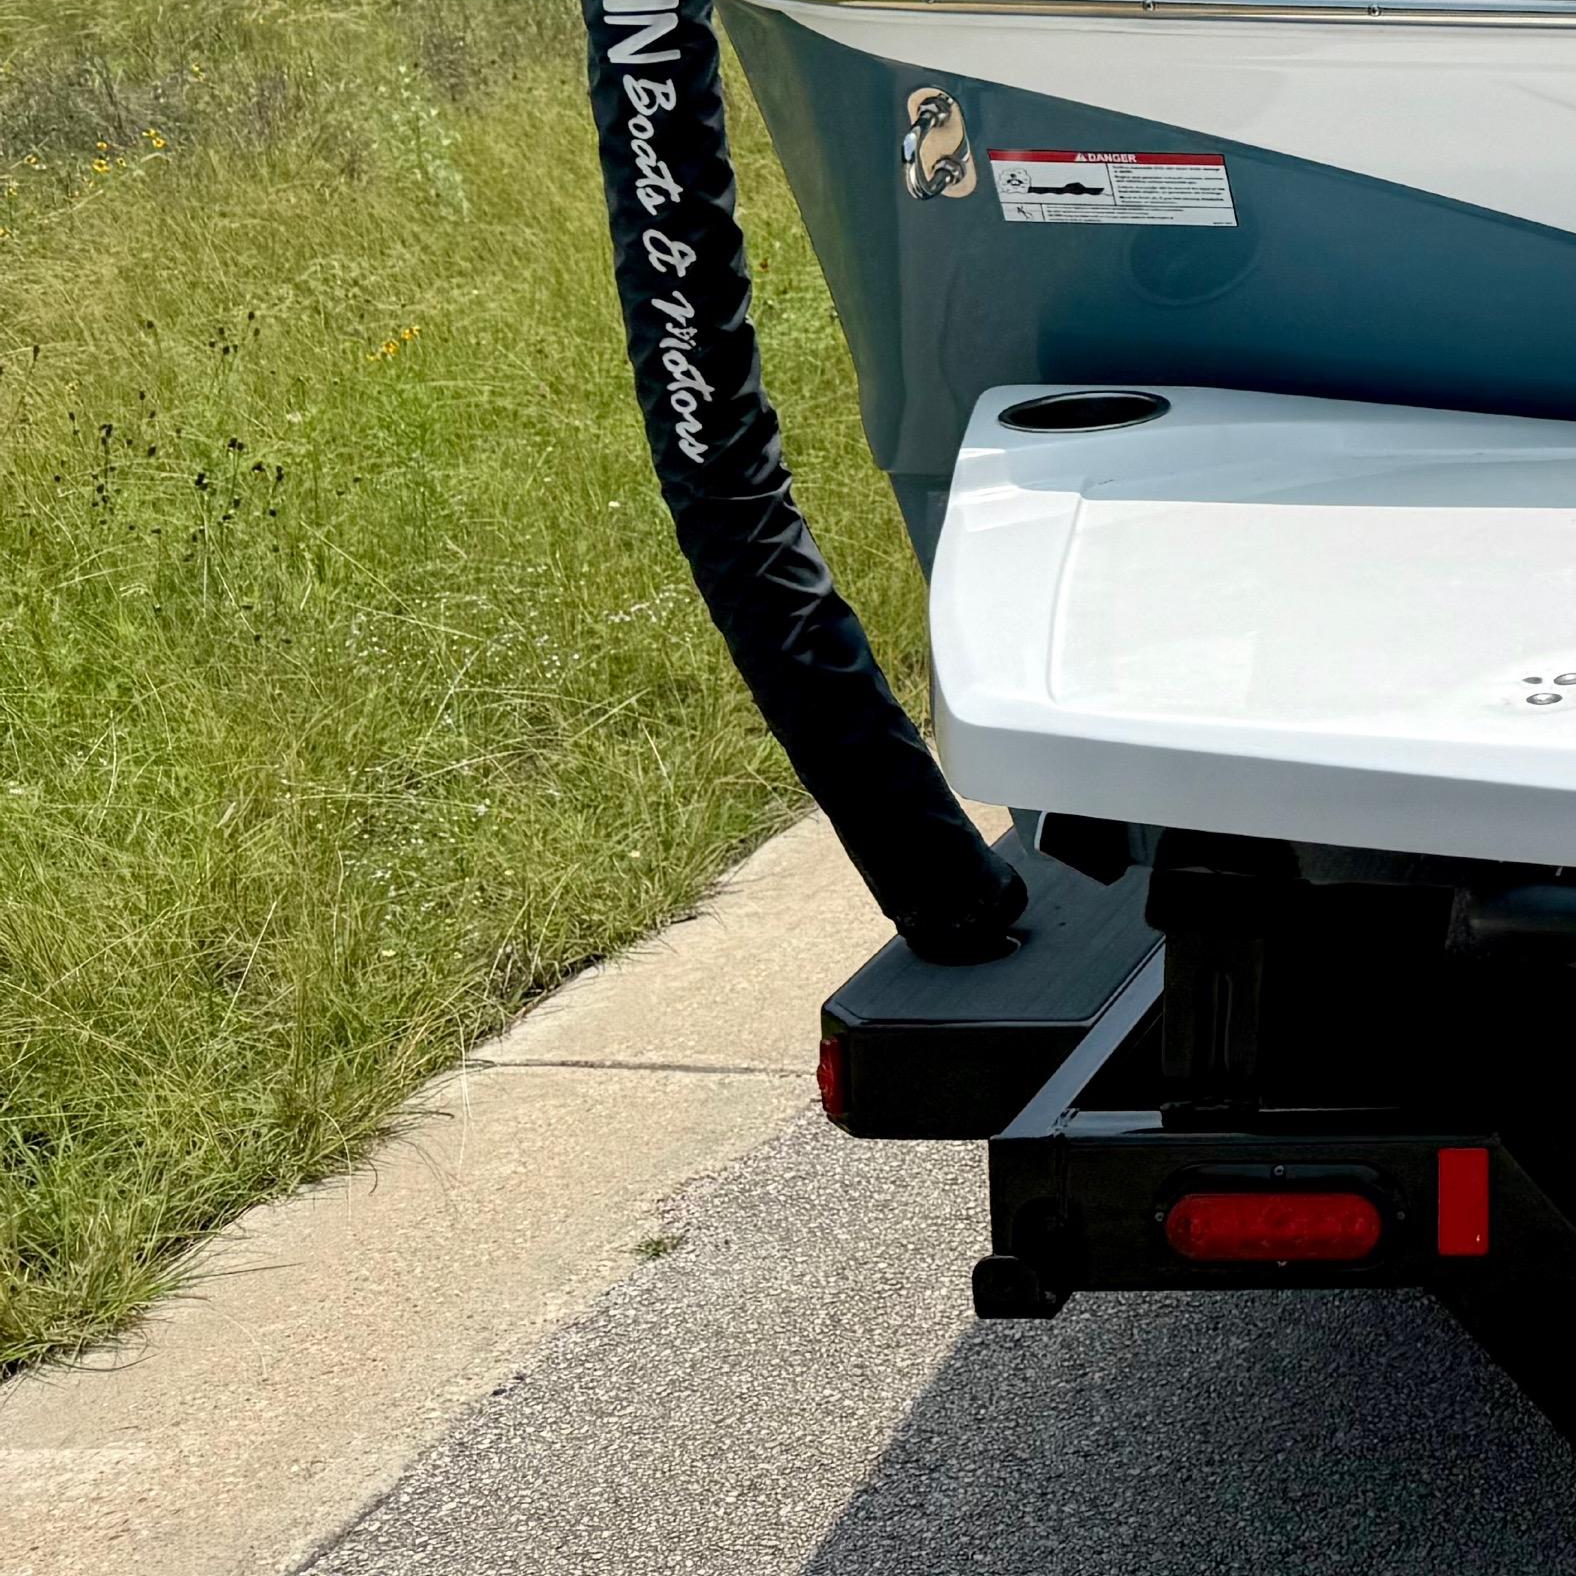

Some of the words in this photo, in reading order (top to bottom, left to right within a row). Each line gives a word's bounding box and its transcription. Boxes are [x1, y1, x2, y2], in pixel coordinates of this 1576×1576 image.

[622, 74, 684, 216] Boats
[1088, 153, 1138, 164] DANGER
[642, 229, 697, 278] &
[651, 290, 716, 464] Motors
